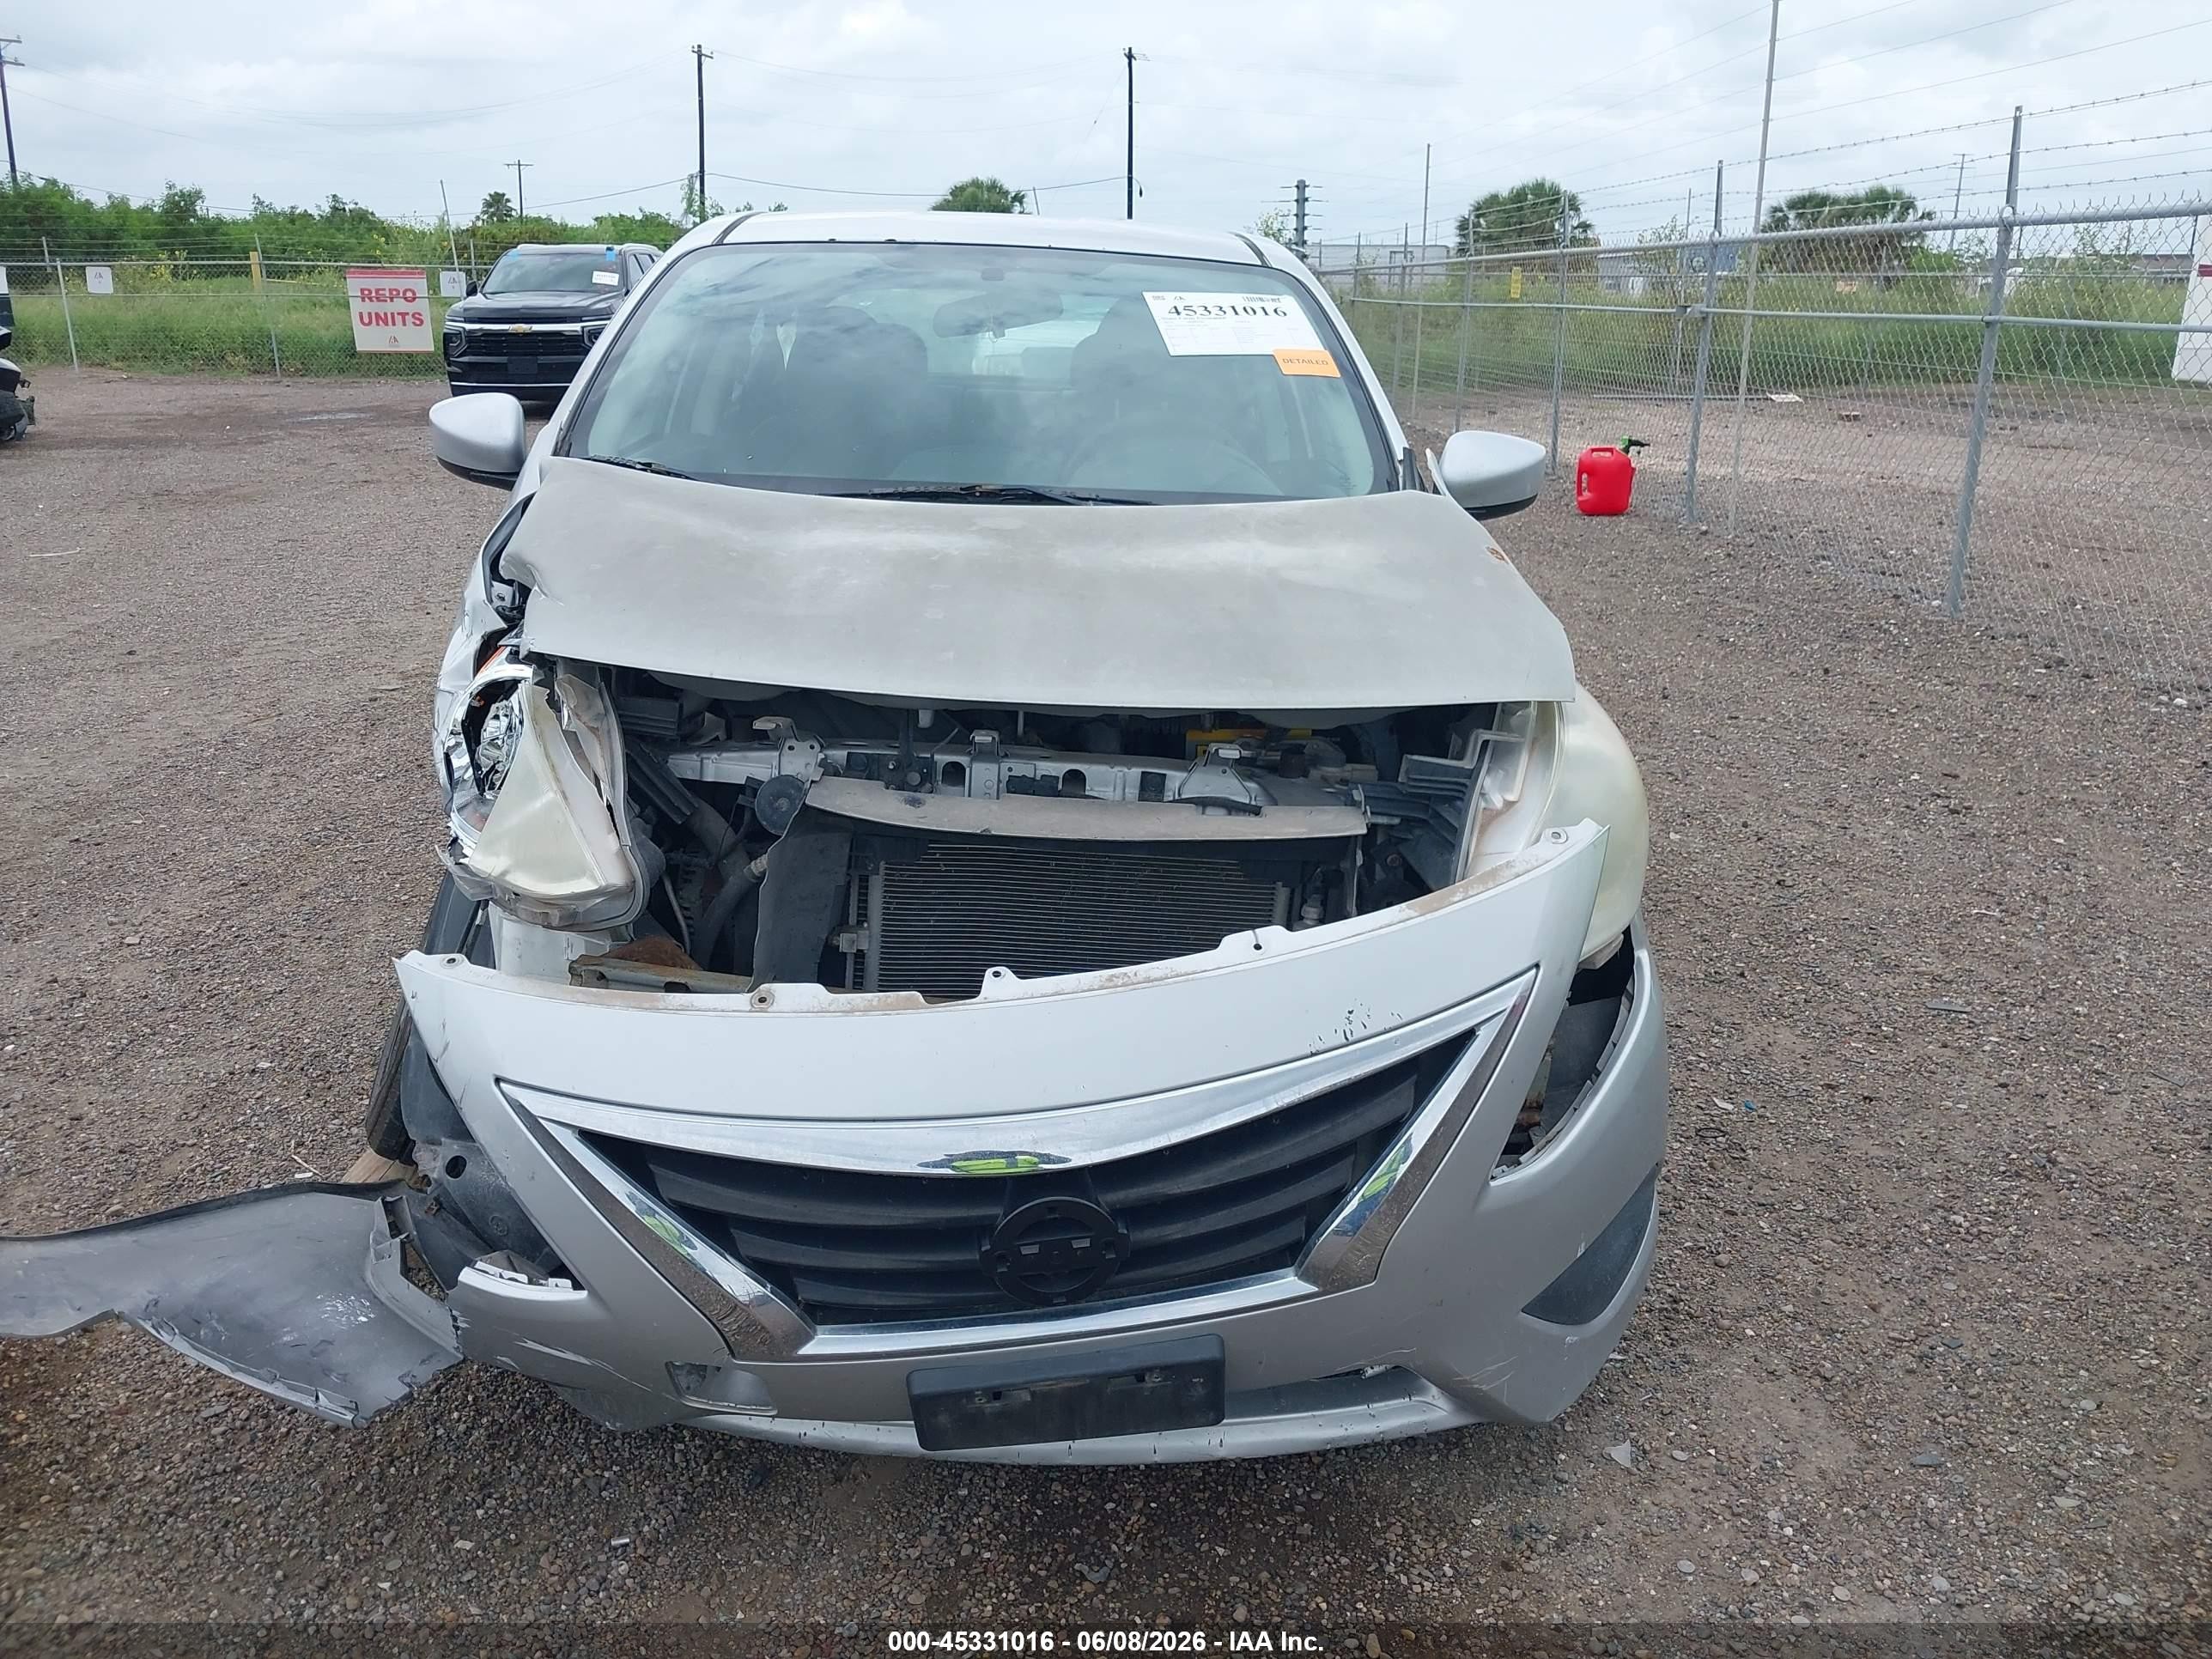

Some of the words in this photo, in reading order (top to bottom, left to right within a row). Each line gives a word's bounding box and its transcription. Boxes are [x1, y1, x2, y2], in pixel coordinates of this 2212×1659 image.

[360, 288, 417, 303] REPO
[358, 311, 425, 327] UNITS
[1168, 305, 1288, 318] 45331016
